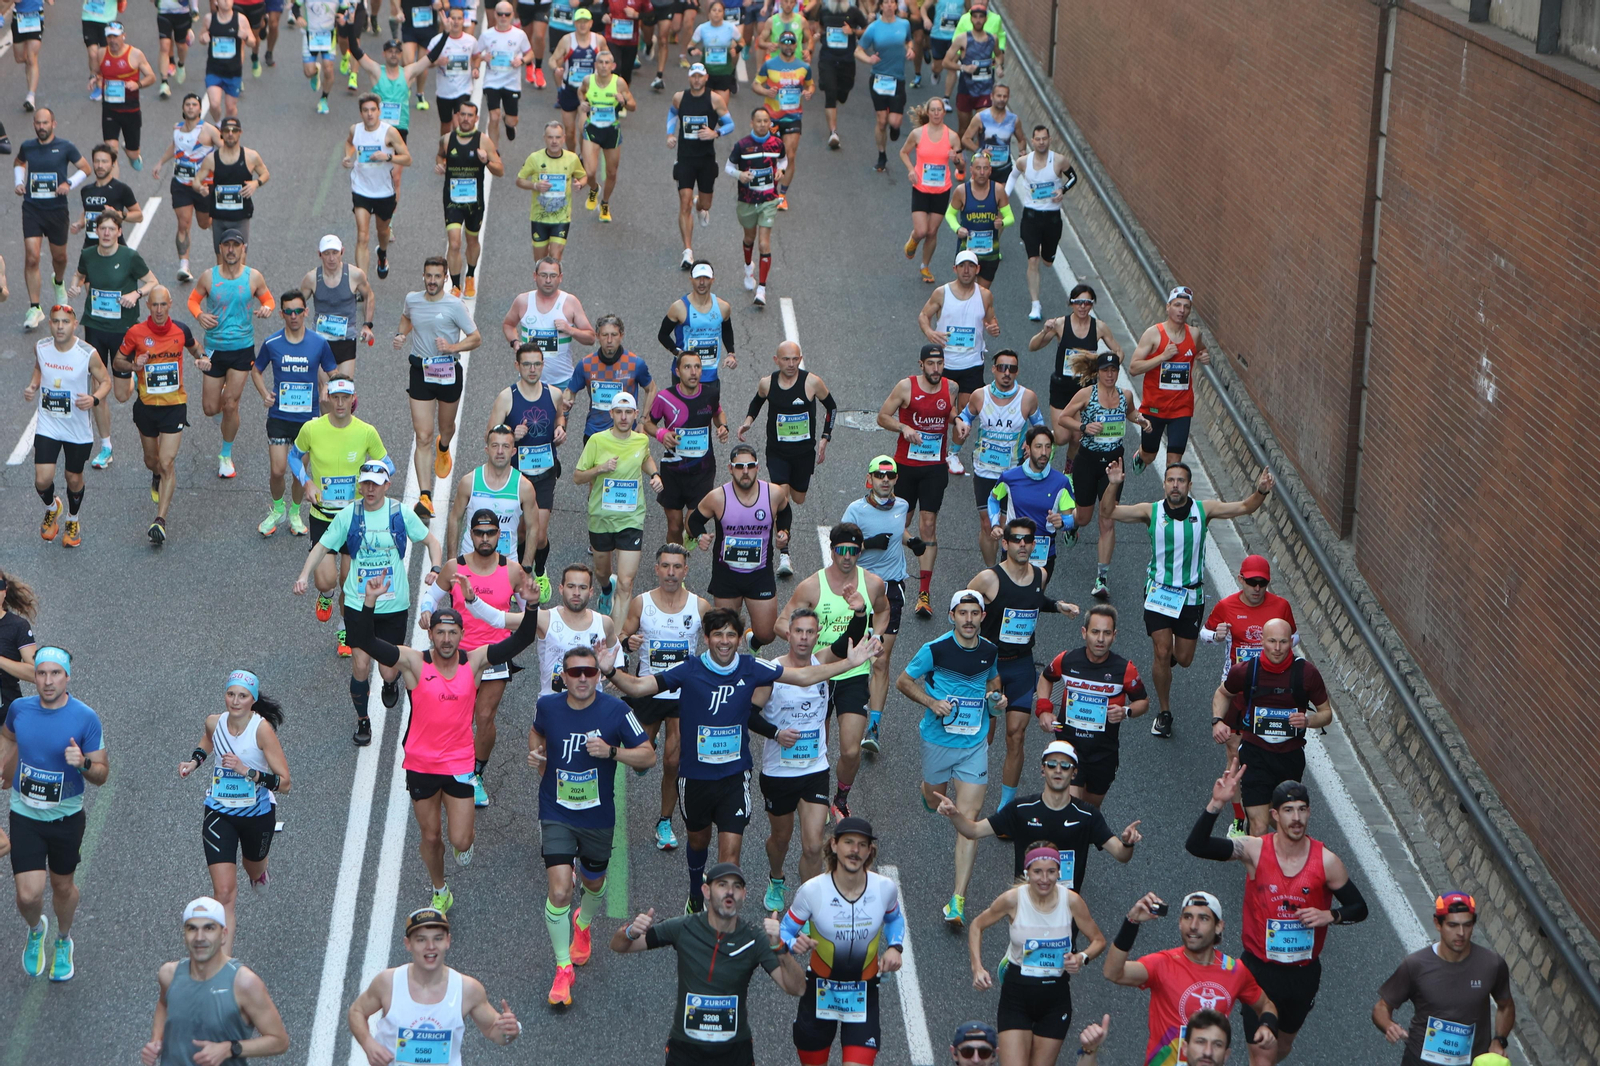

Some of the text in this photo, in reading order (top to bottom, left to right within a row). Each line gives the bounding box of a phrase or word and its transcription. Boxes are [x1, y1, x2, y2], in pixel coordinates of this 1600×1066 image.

[281, 355, 308, 363] ¡Vamos,
[45, 362, 73, 371] MARATÓN
[32, 772, 58, 781] ZURICH
[30, 784, 46, 793] 3112
[416, 911, 435, 920] ciele
[835, 929, 868, 940] ANTONIO
[703, 1014, 719, 1022] 3208
